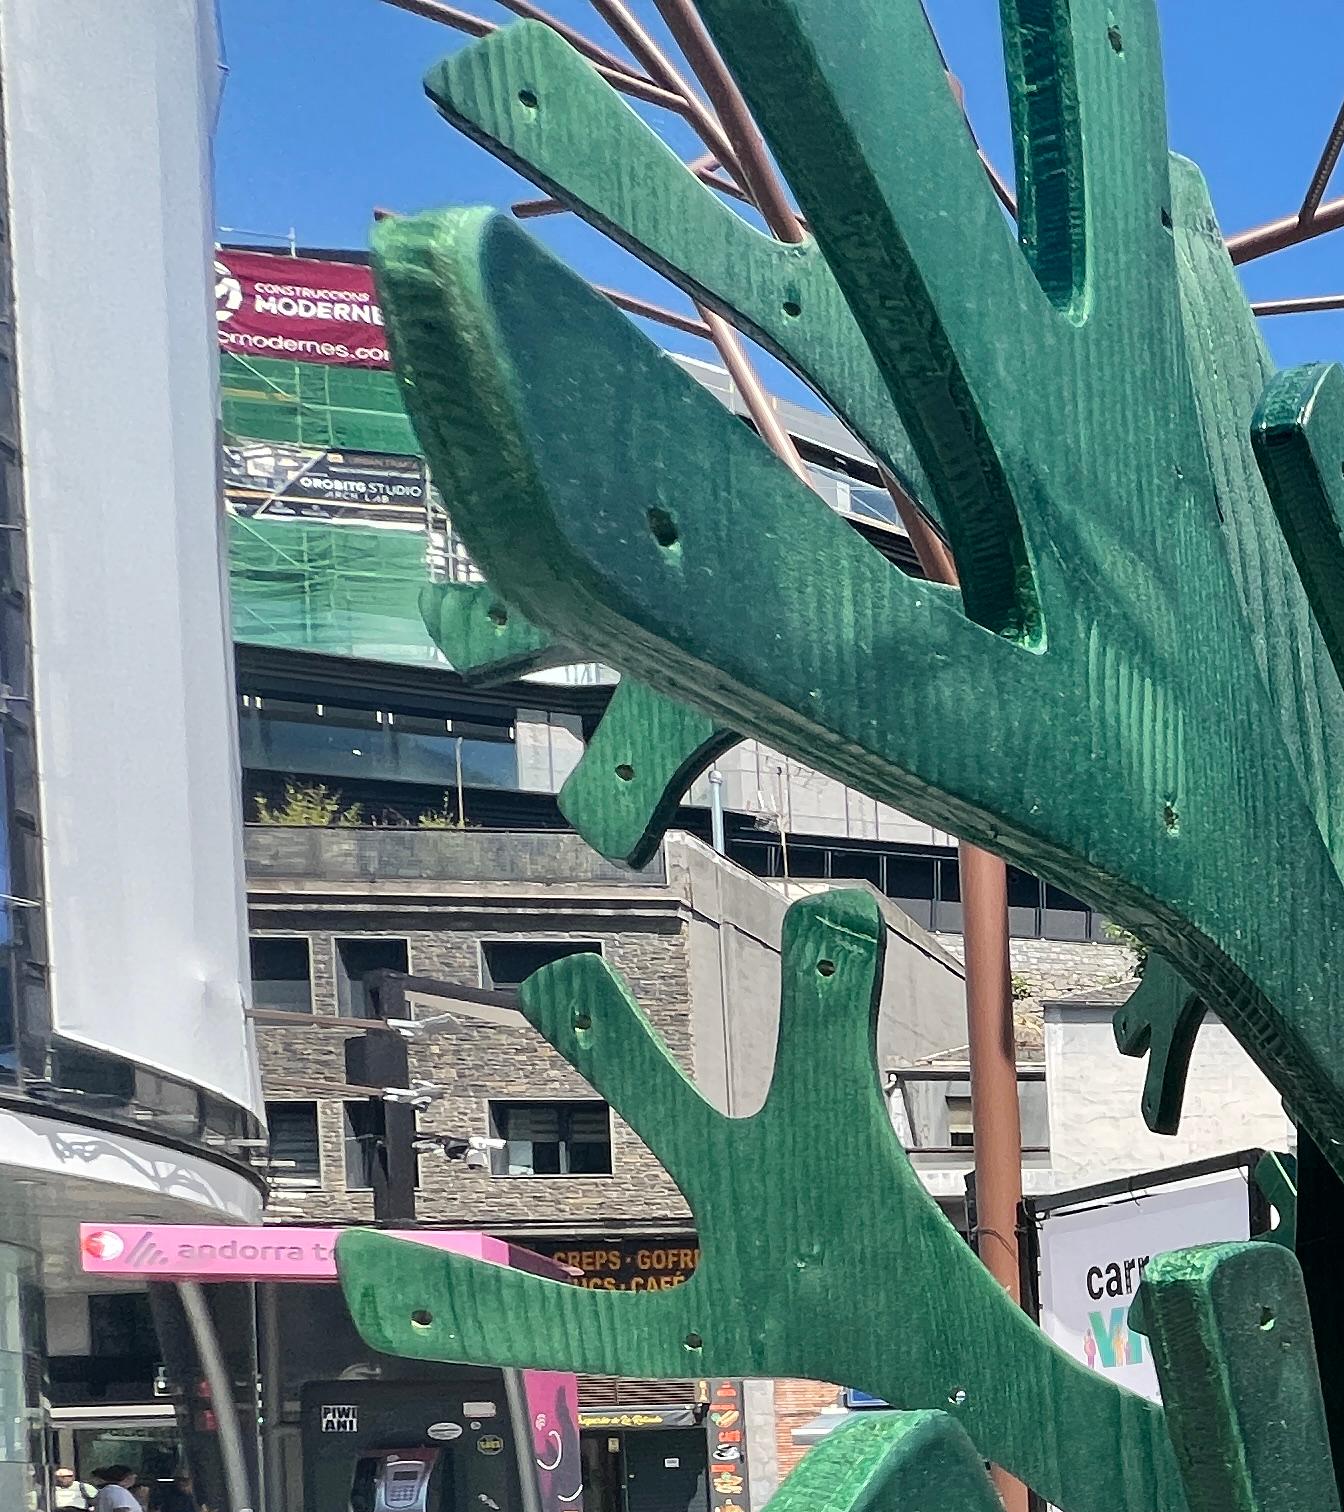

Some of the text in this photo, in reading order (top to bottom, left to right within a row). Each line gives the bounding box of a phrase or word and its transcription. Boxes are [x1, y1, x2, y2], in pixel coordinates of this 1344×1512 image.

[254, 282, 370, 303] CONSTRUCCIONS
[255, 295, 385, 326] MODERNE
[367, 482, 422, 497] STUDIO
[178, 1240, 303, 1261] andorra
